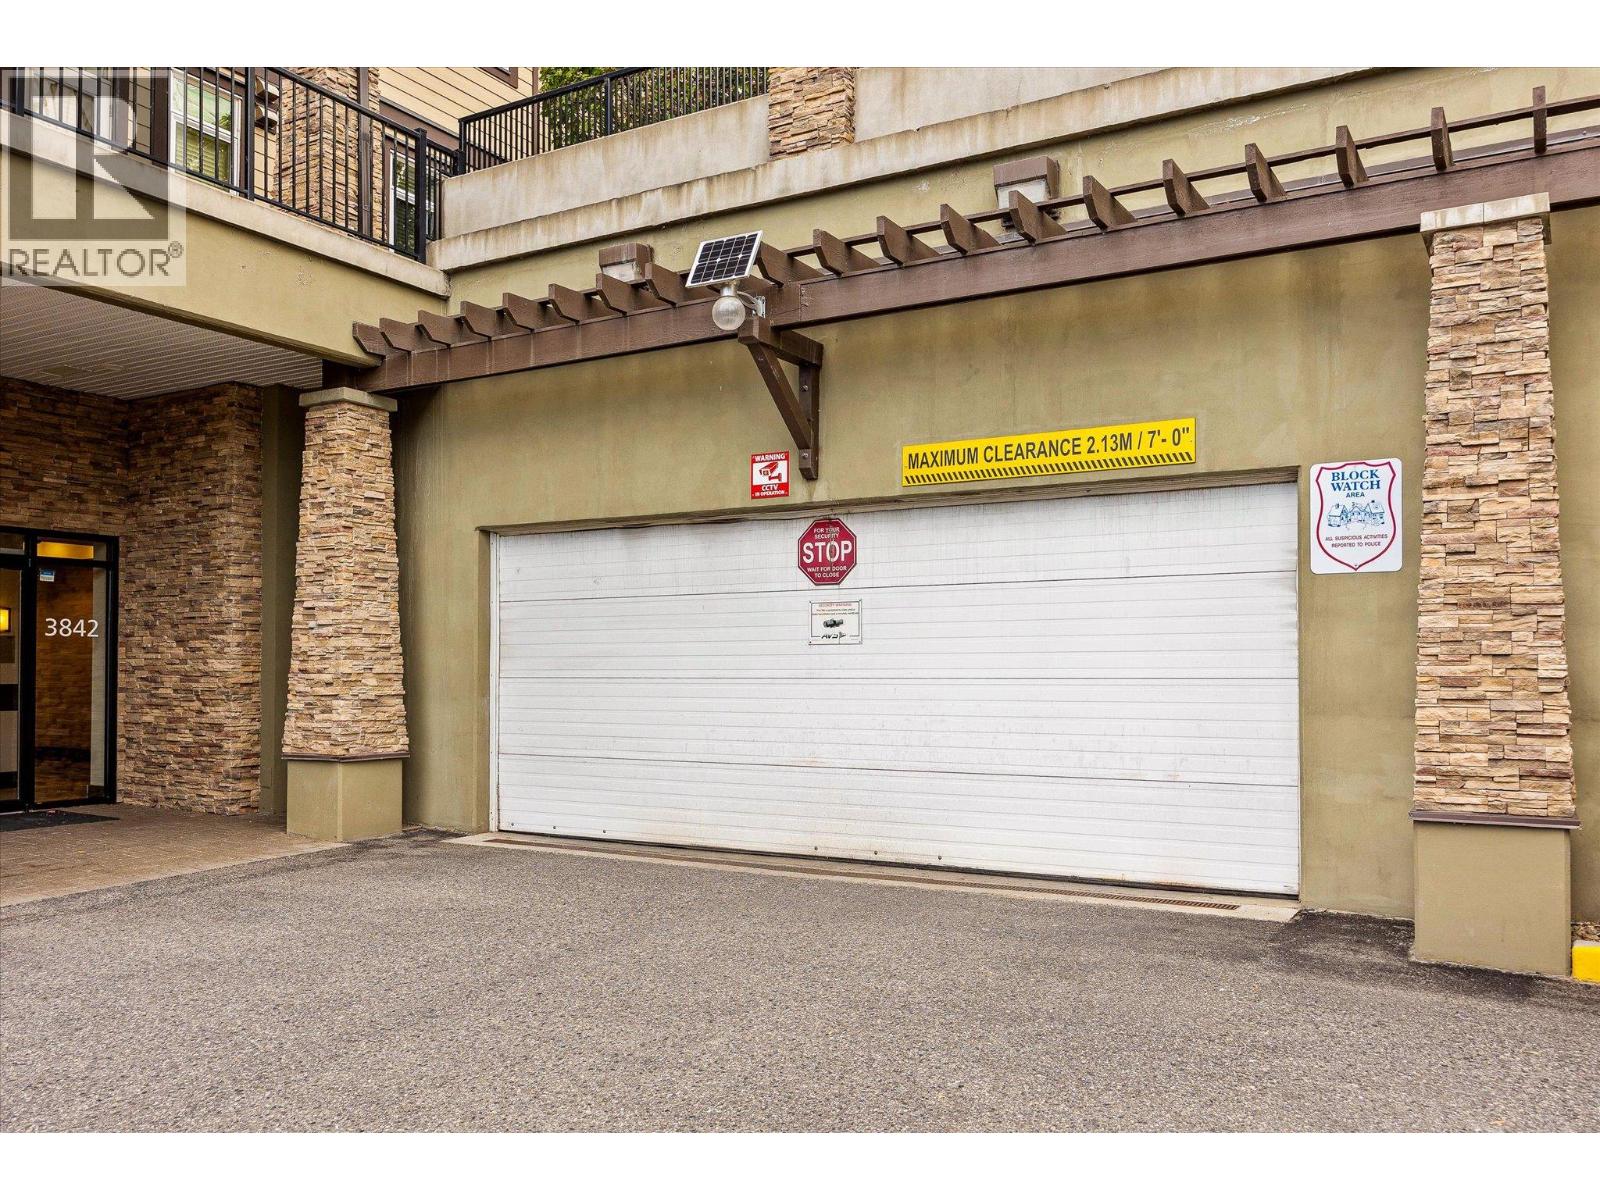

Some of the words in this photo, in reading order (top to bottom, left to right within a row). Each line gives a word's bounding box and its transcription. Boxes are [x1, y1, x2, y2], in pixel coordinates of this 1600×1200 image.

[908, 446, 979, 470] MAXIMUM
[983, 437, 1081, 463] CLEARANCE
[1086, 432, 1133, 454] 2.13M
[754, 453, 786, 462] WARNING
[1331, 469, 1380, 482] BLOCK
[761, 483, 779, 491] CCTV
[1331, 480, 1381, 492] WATCH
[1346, 491, 1366, 499] AREA
[802, 540, 853, 564] STOP
[44, 618, 100, 638] 3842
